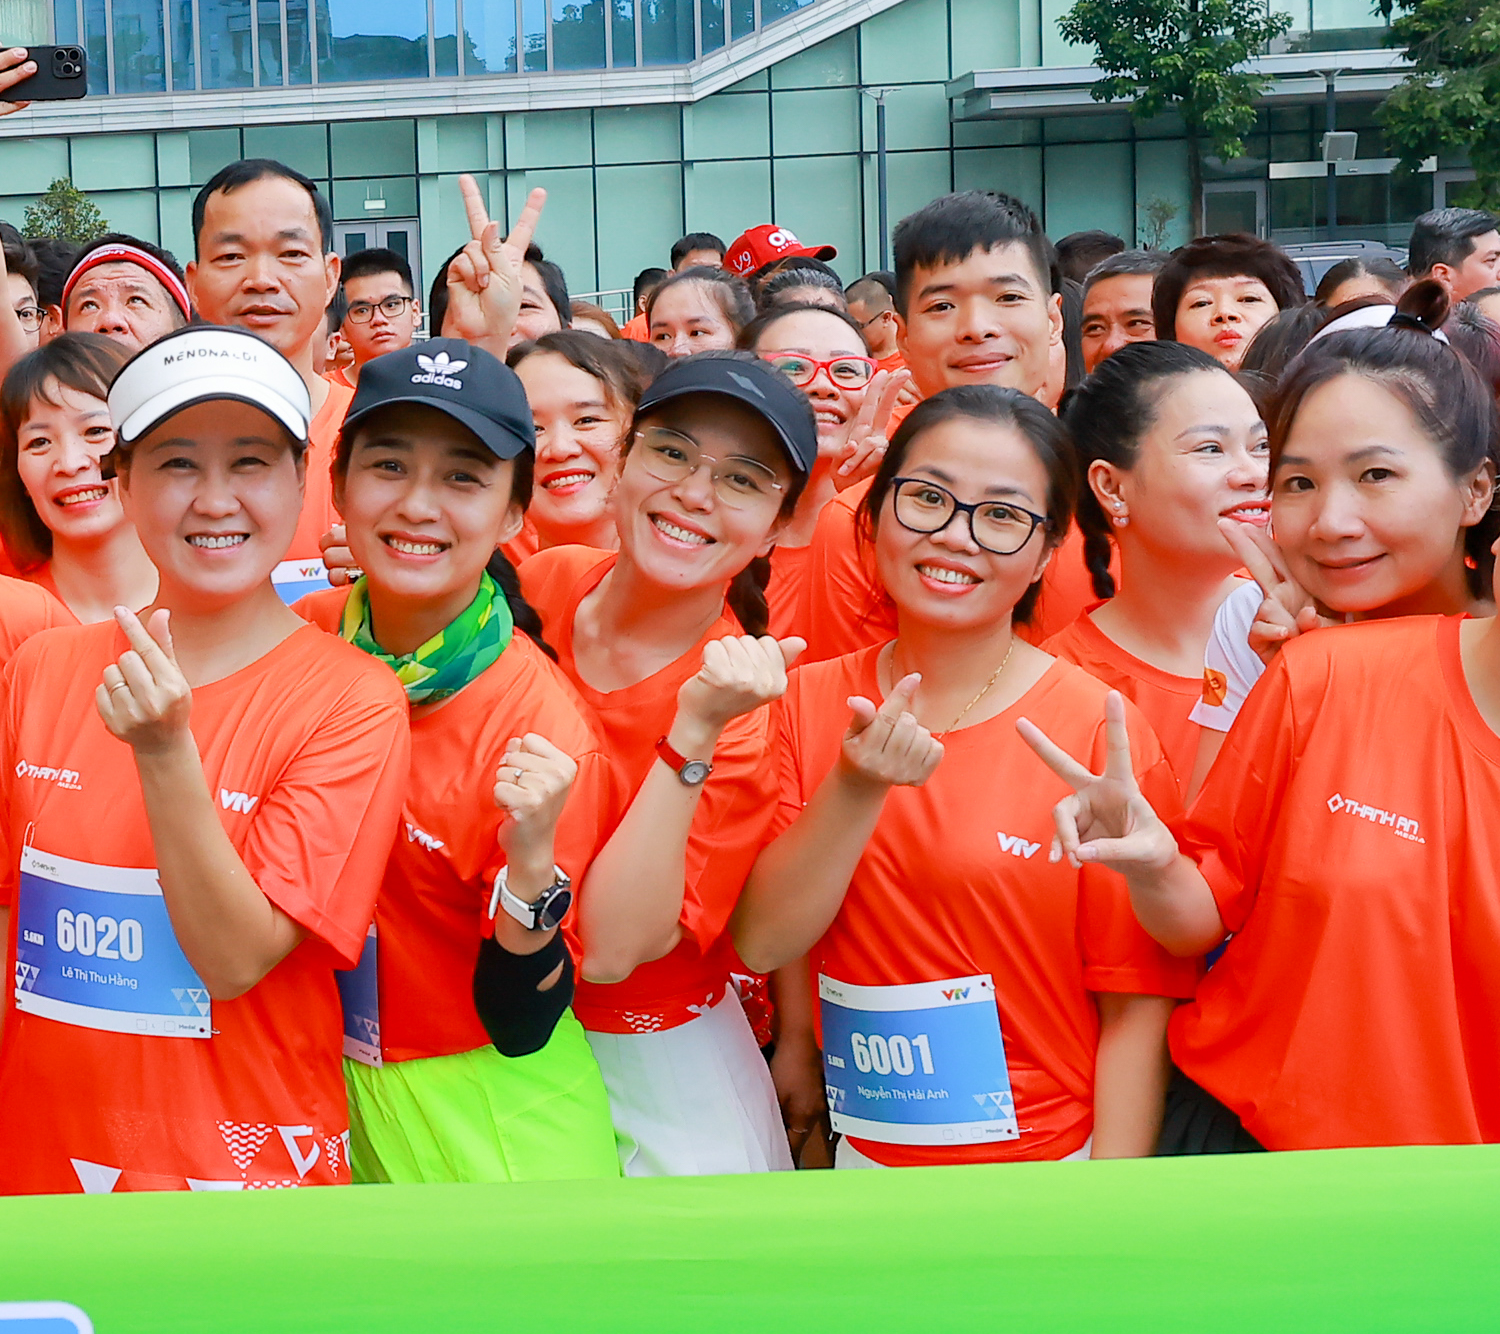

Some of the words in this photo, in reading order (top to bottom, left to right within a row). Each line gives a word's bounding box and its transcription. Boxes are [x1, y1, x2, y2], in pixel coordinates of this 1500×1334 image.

[411, 373, 463, 391] adidas
[298, 566, 322, 578] VTV
[57, 780, 82, 790] MEDIA
[60, 769, 80, 783] AN
[220, 788, 259, 815] VTV
[1344, 798, 1397, 828] THANH
[1396, 816, 1421, 835] AN
[996, 832, 1042, 858] VTV
[1394, 830, 1426, 844] MEDIA
[56, 908, 145, 962] 6020
[62, 965, 74, 979] Lê
[74, 968, 89, 983] Thị
[89, 971, 108, 984] Thu
[941, 986, 971, 1000] VTV
[849, 1031, 935, 1077] 6001
[927, 1088, 950, 1099] Anh
